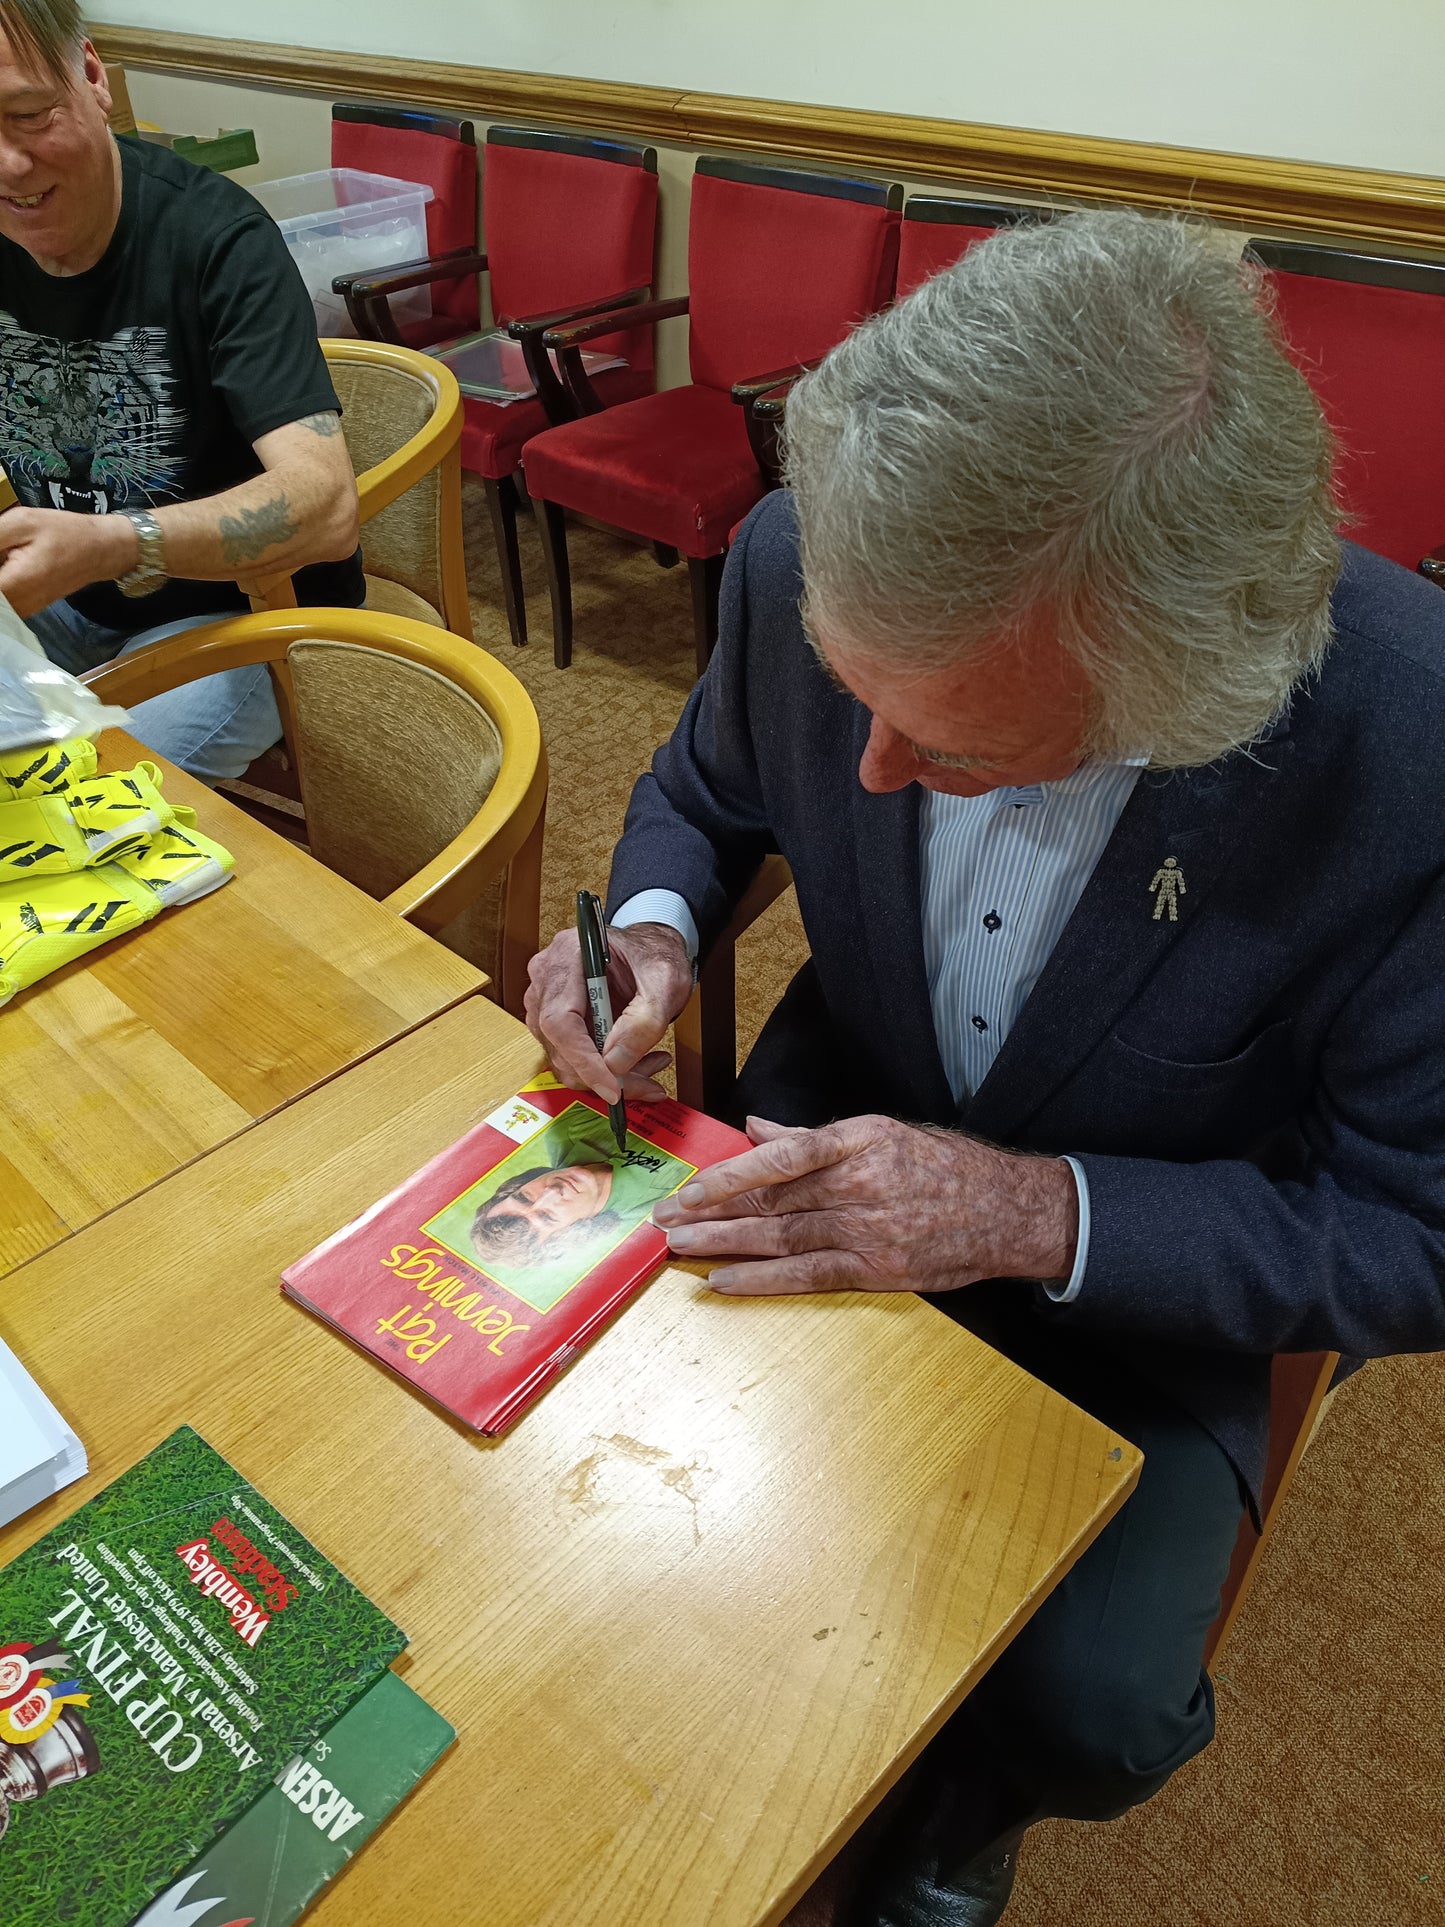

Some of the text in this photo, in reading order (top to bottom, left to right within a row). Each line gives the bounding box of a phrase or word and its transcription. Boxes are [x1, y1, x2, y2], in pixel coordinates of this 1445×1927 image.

[595, 1023, 606, 1055] arpie
[377, 1303, 451, 1364] Pat
[380, 1244, 531, 1358] Jennings
[127, 1547, 148, 1573] 3pm
[210, 1516, 299, 1612] Stadium
[230, 1494, 325, 1592] Official Souvenir Programme 50p
[167, 1597, 192, 1620] 1979
[175, 1537, 271, 1647] Wembley
[186, 1614, 209, 1640] May
[47, 1588, 203, 1773] CUP FINAL
[55, 1542, 263, 1772] Arsenal v Manchester United
[96, 1542, 265, 1733] Football Association Challenge Cup Competition
[203, 1633, 224, 1657] 12th
[219, 1651, 259, 1695] Saturday
[275, 1754, 365, 1842] ARSEN
